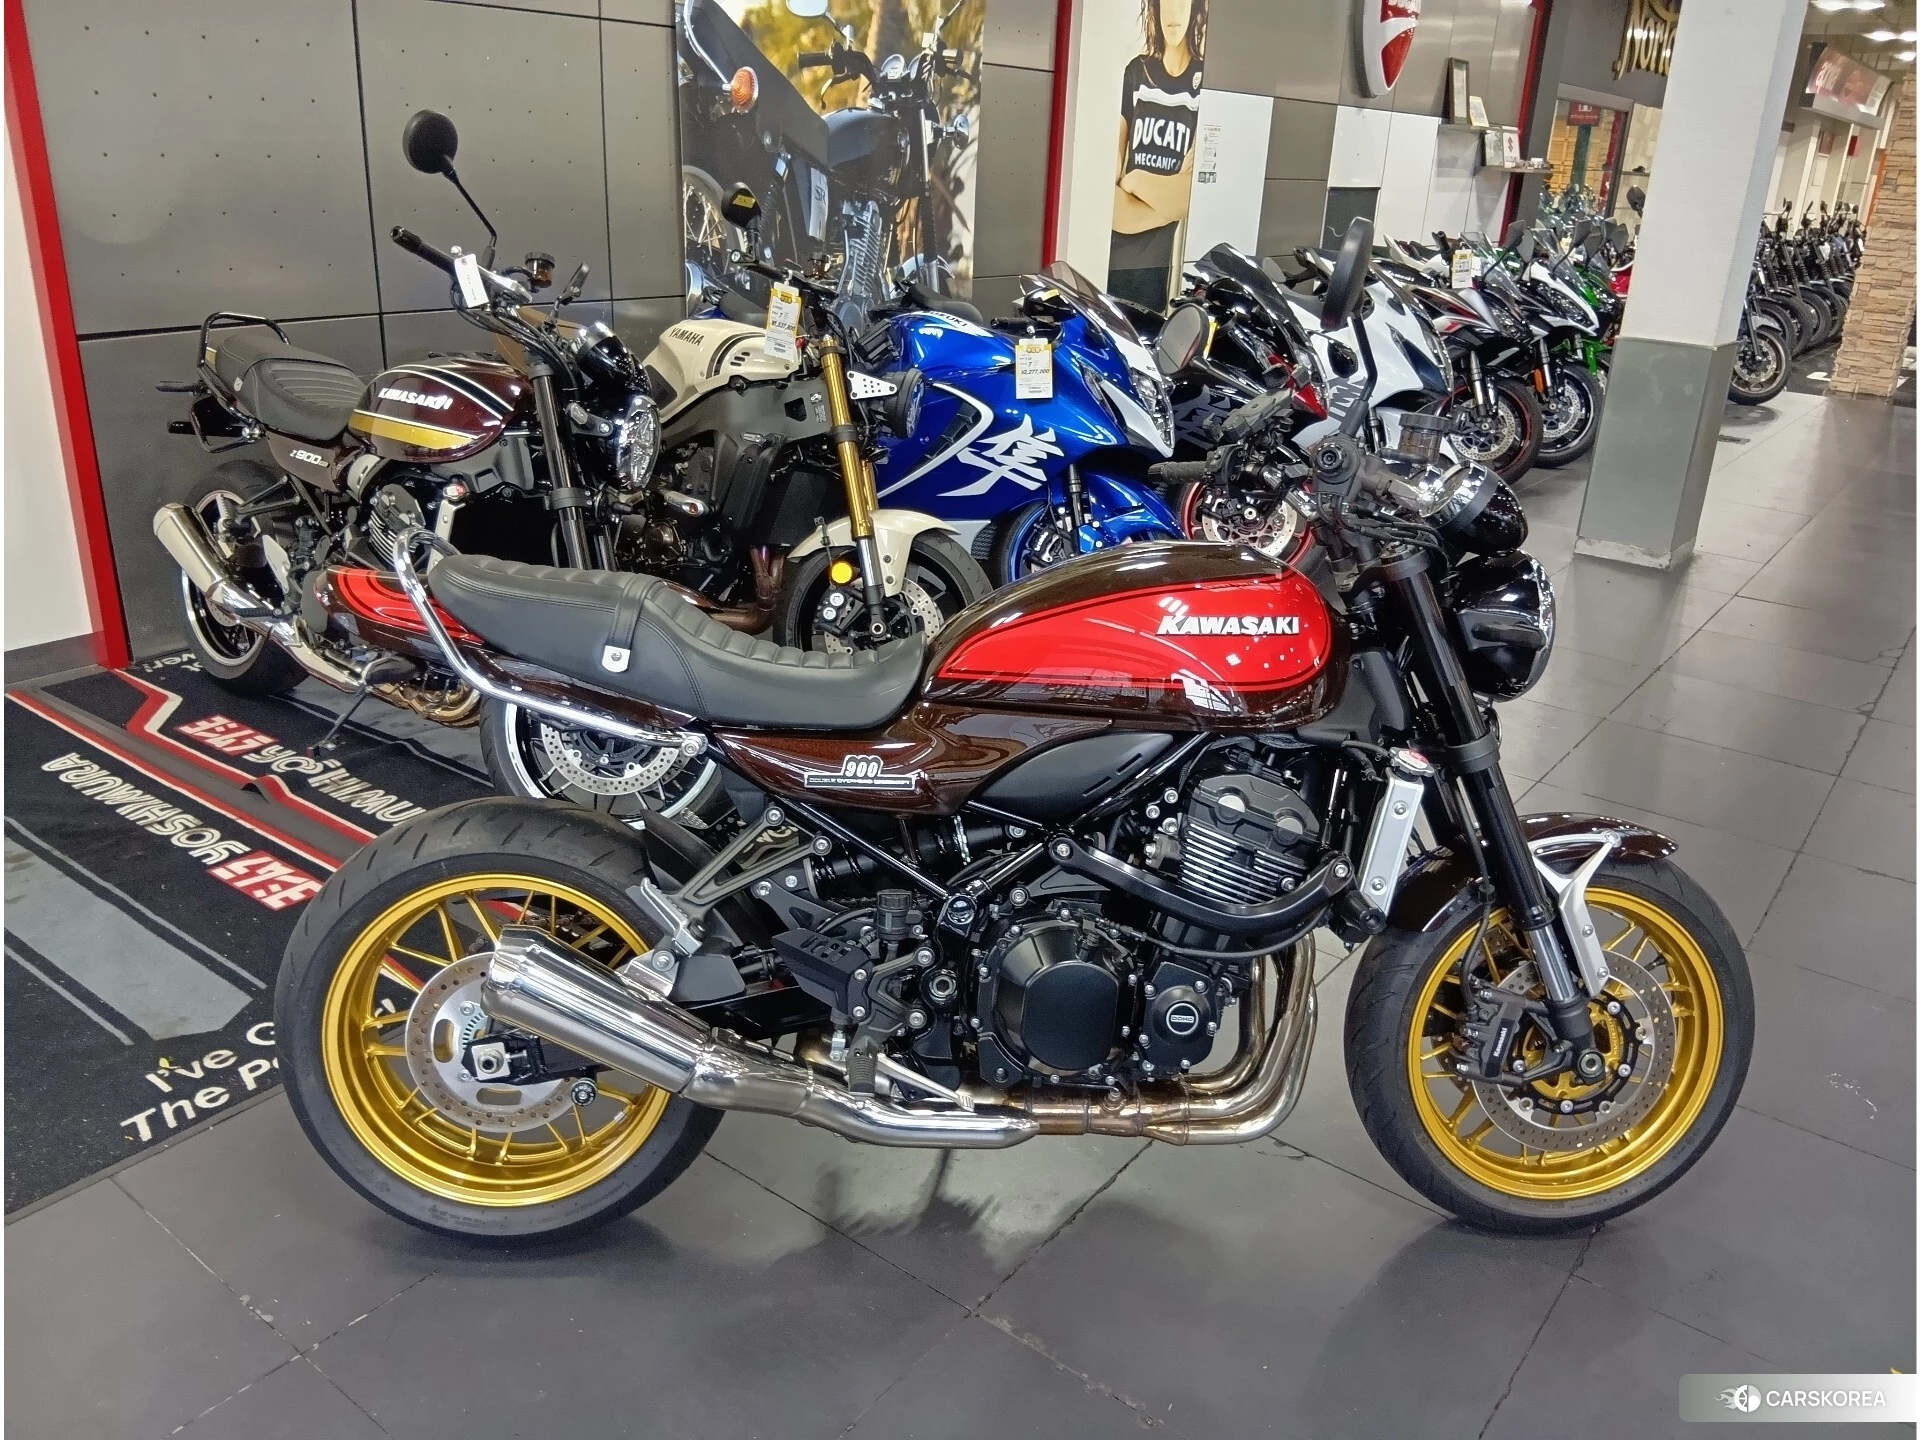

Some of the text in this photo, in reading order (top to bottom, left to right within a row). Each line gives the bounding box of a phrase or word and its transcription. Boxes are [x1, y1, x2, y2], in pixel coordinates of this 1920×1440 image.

[1132, 116, 1191, 156] DUCATI
[669, 327, 705, 347] YAMAHA
[378, 387, 454, 410] KAWASAKI
[936, 412, 1065, 497] 隼
[1155, 614, 1301, 637] KAWASAKI
[845, 761, 879, 778] 900
[41, 752, 252, 866] YOSHIMURA
[1492, 1027, 1508, 1057] Kawasaki
[145, 1049, 237, 1093] I've
[120, 1086, 230, 1142] The
